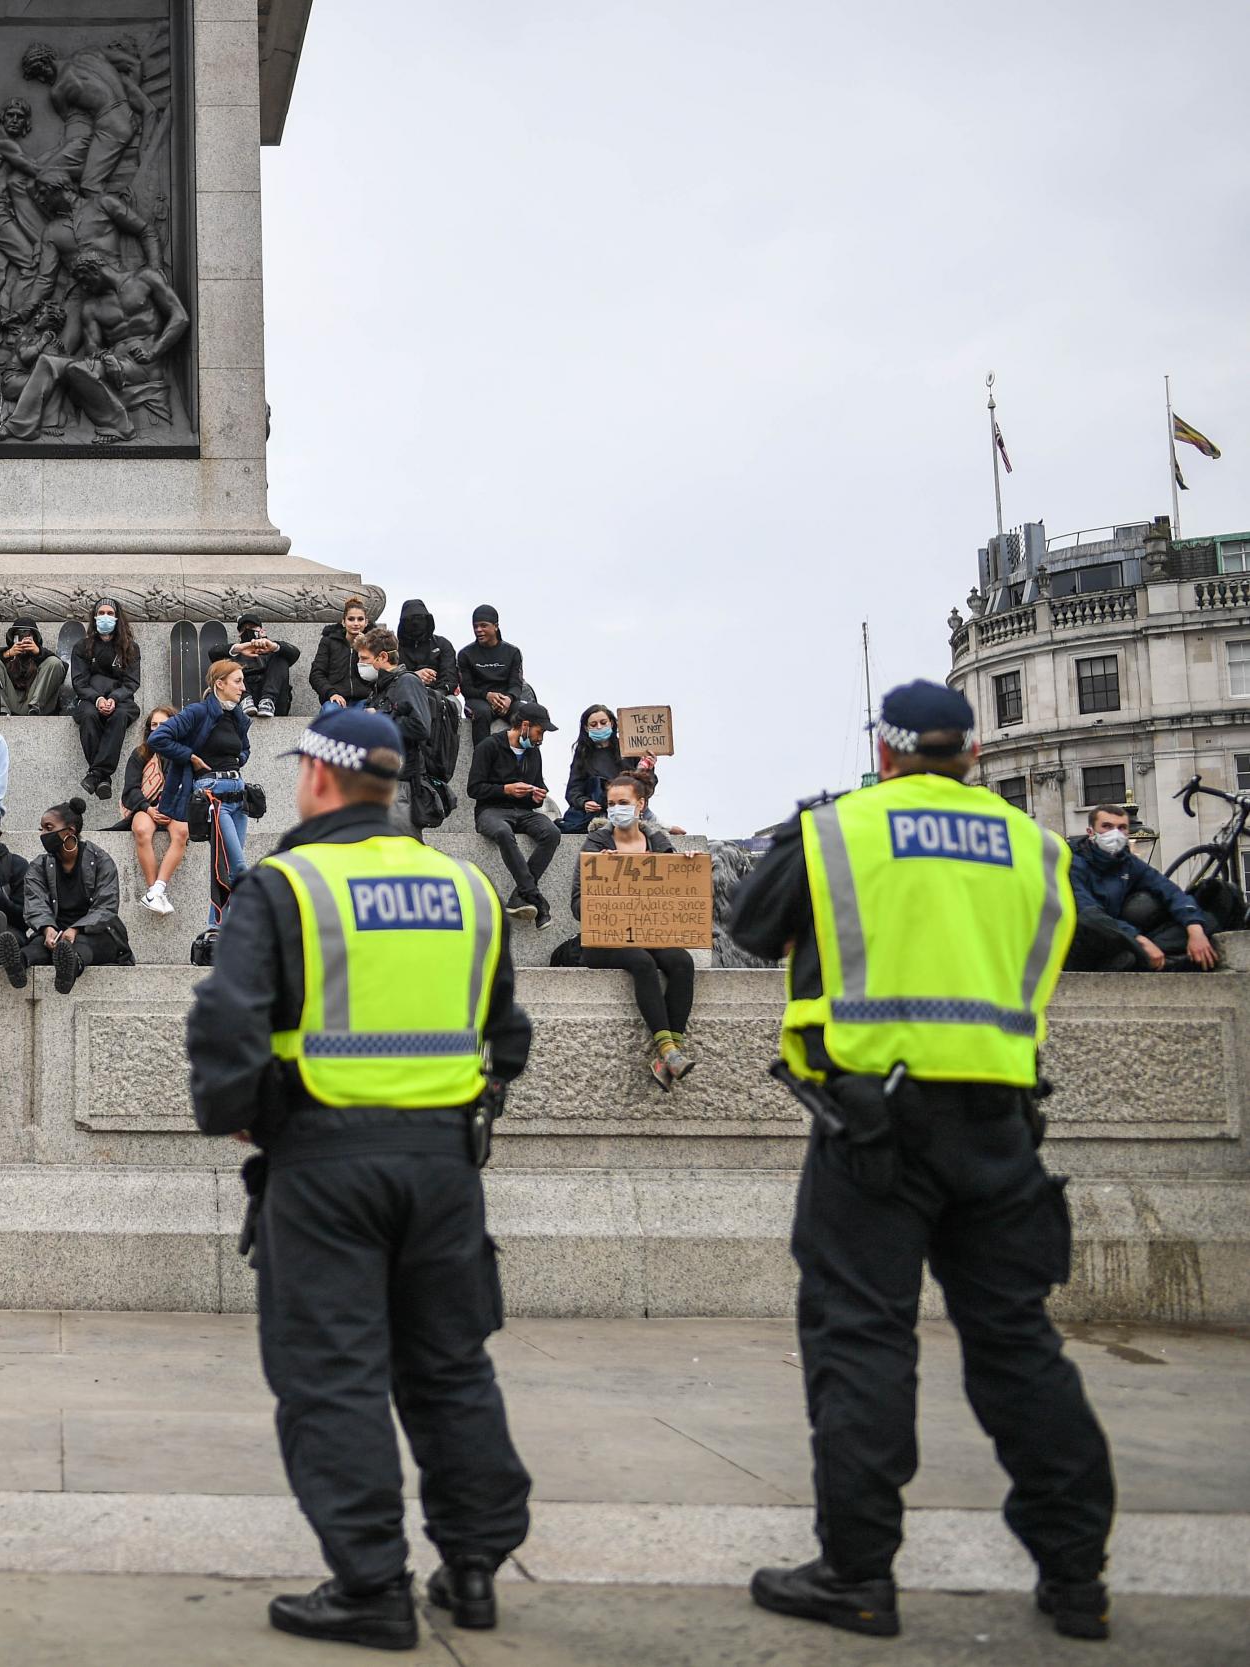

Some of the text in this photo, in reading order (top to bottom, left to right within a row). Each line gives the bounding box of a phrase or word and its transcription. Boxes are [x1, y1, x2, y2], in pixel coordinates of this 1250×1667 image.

[630, 714, 666, 724] THE UK
[636, 725, 663, 733] IS NOT
[628, 735, 666, 748] INNOCENT
[892, 814, 1009, 858] POLICE
[584, 856, 702, 882] 1,741 people
[628, 884, 641, 900] by
[646, 885, 681, 899] police
[686, 886, 698, 896] in
[353, 882, 461, 922] POLICE
[677, 900, 706, 911] since
[672, 912, 706, 924] MORE
[589, 929, 624, 943] THAN
[625, 926, 635, 943] 1
